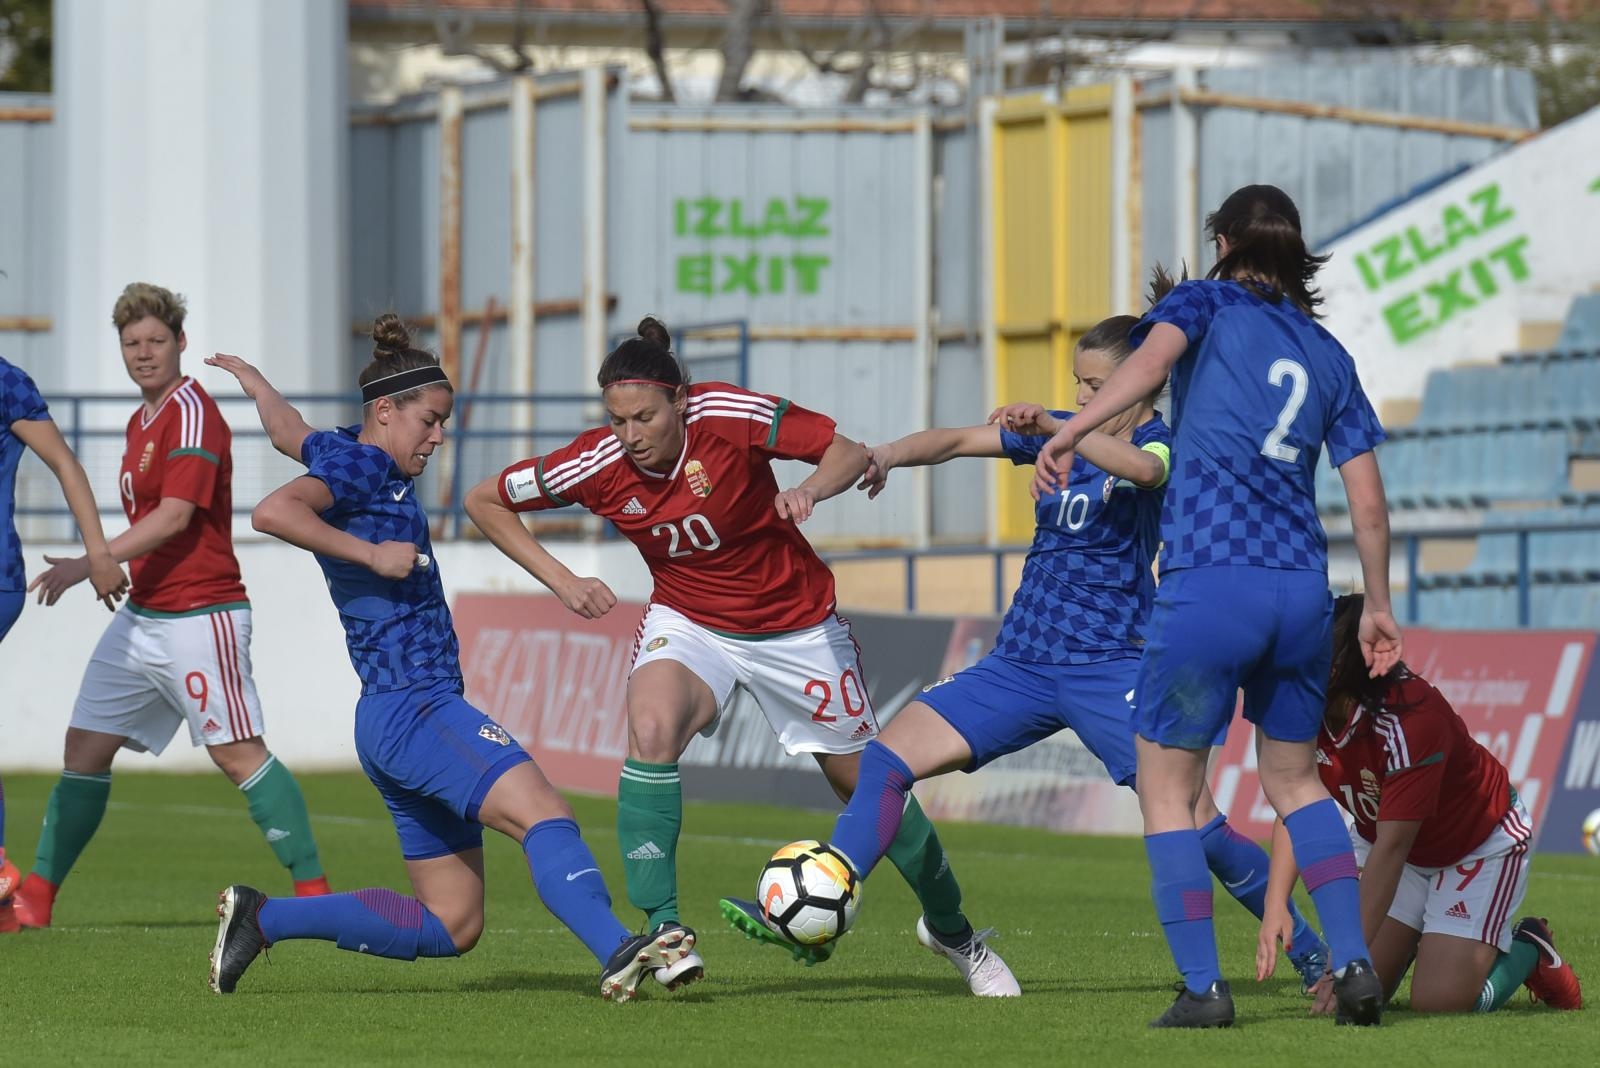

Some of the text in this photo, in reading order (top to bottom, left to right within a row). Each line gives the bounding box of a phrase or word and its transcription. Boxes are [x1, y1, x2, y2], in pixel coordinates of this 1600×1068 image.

[674, 194, 831, 239] IZLAZ
[1355, 182, 1515, 291] IZLAZ
[675, 254, 831, 296] EXIT
[1381, 233, 1530, 345] EXIT
[1260, 358, 1309, 464] 2
[122, 471, 136, 515] 9
[1056, 489, 1090, 530] 10
[652, 513, 720, 558] 20
[185, 671, 208, 713] 9
[803, 668, 865, 722] 20
